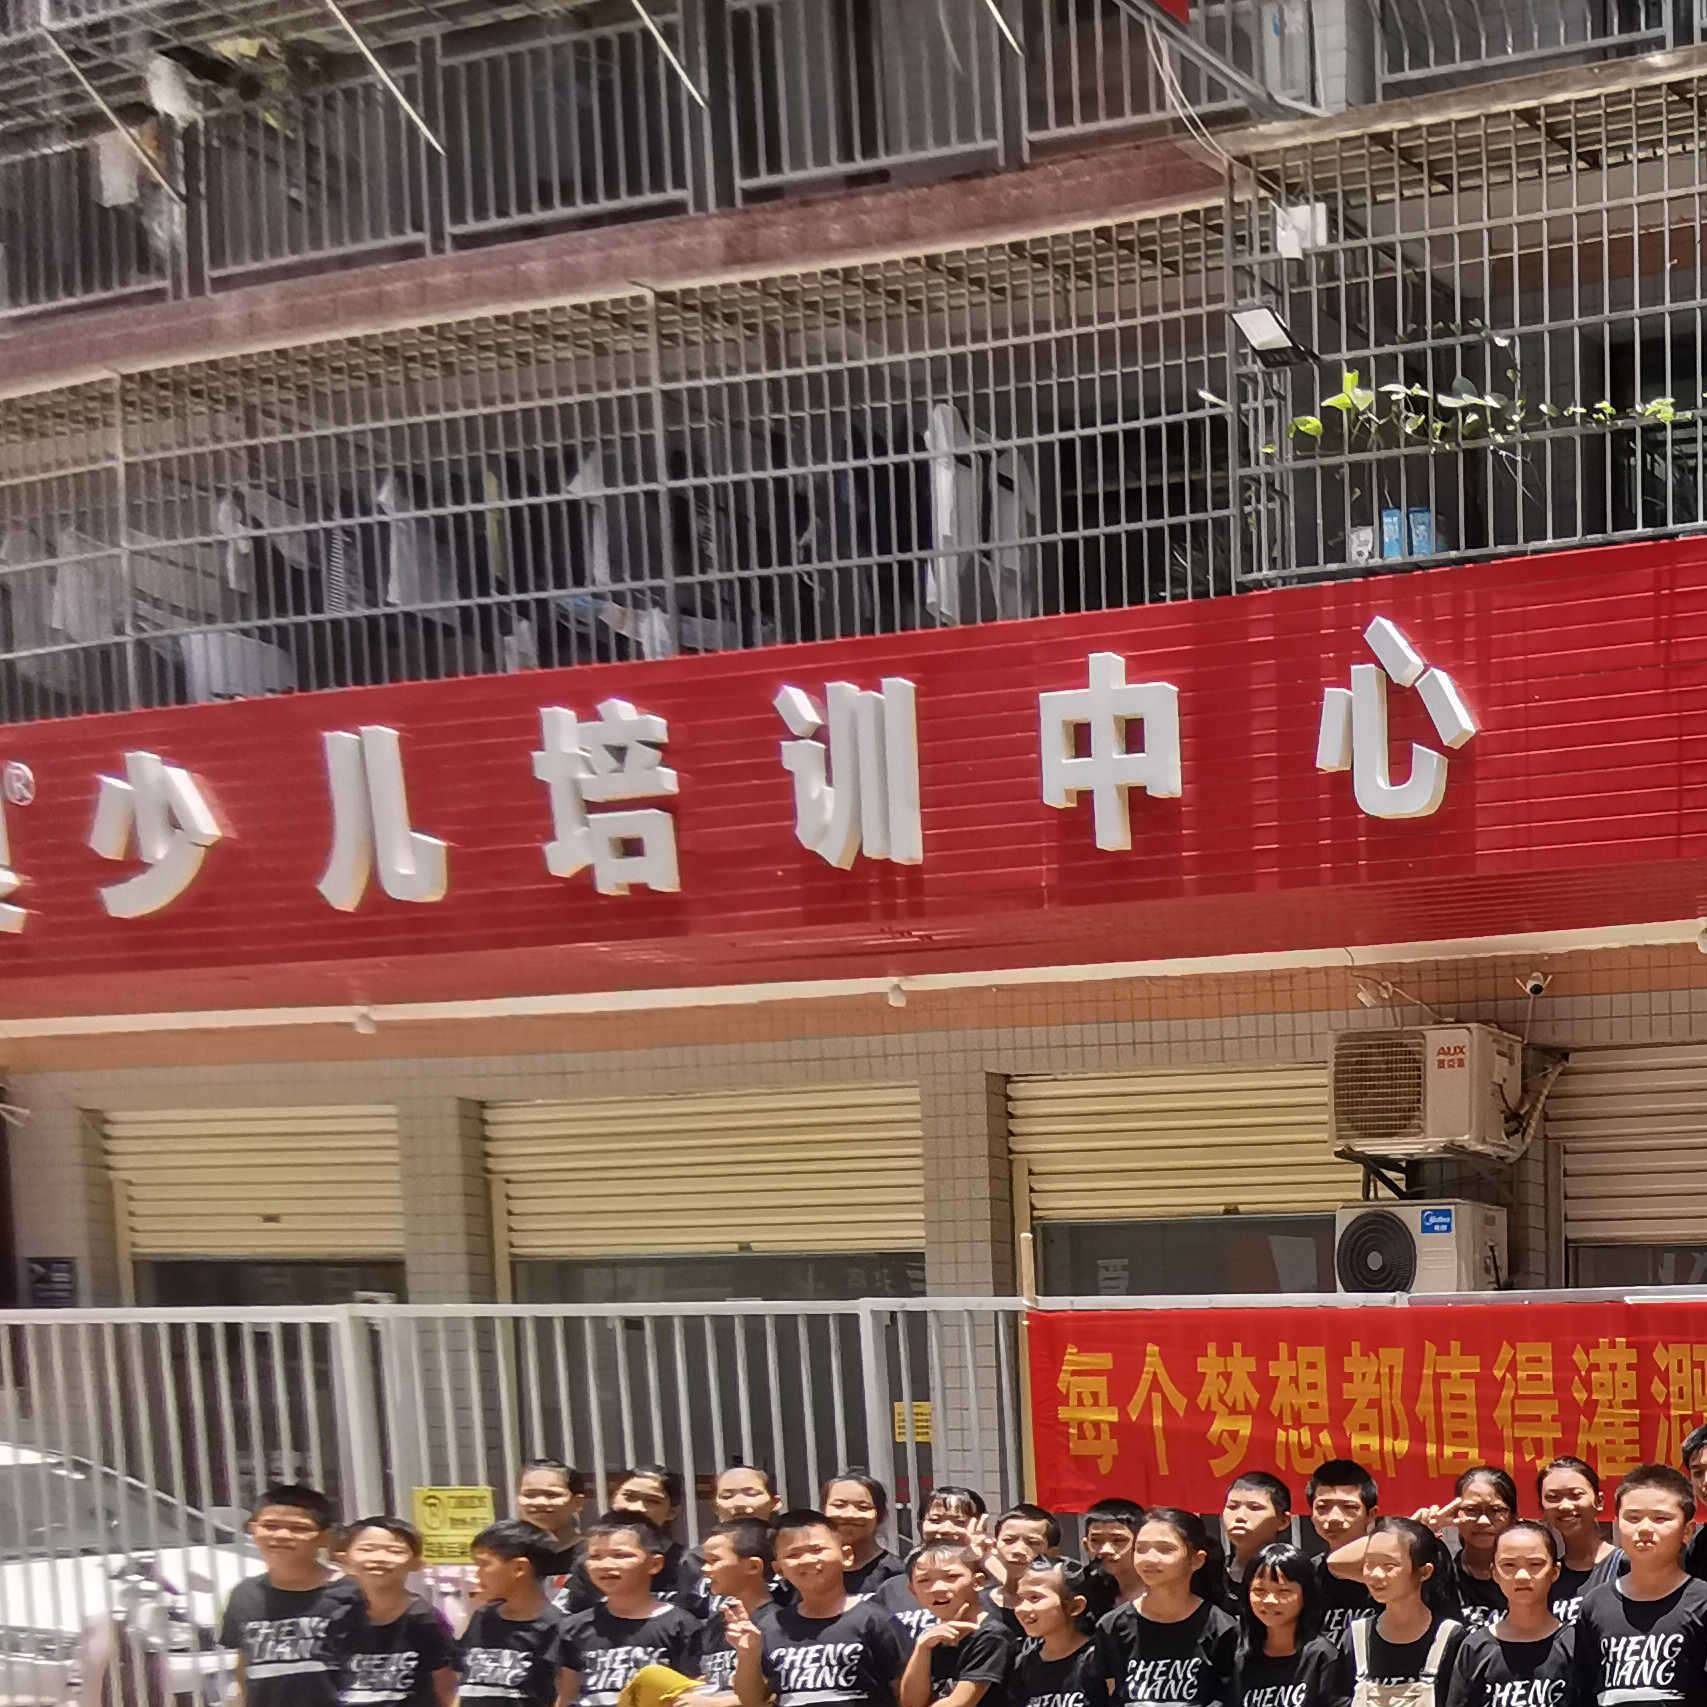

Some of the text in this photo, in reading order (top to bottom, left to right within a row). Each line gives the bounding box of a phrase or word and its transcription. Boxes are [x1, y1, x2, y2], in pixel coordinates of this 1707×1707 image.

[88, 615, 1480, 918] 少儿培训中心
[769, 1642, 863, 1669] CHENG
[1604, 1657, 1675, 1689] LIANG
